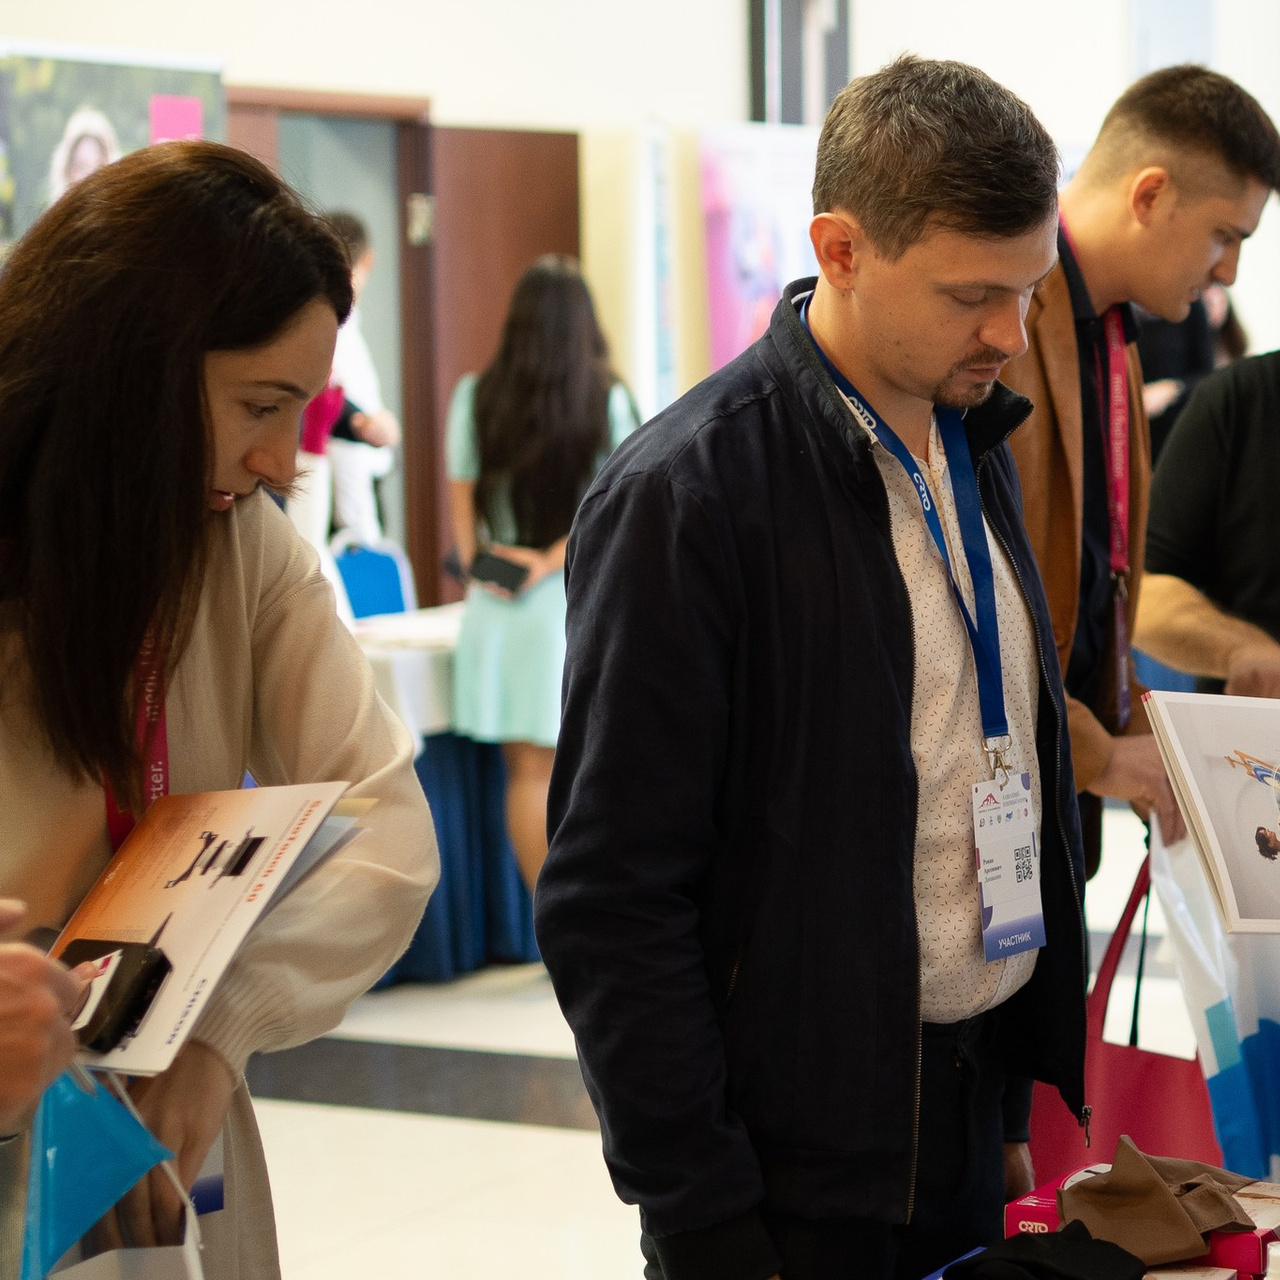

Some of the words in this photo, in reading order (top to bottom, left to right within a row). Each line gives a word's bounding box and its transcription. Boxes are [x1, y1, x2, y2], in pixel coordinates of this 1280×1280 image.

[914, 473, 930, 511] ORTO
[150, 760, 164, 803] tter.
[998, 930, 1032, 949] УЧАСТНИК
[1018, 1219, 1049, 1234] ORTO
